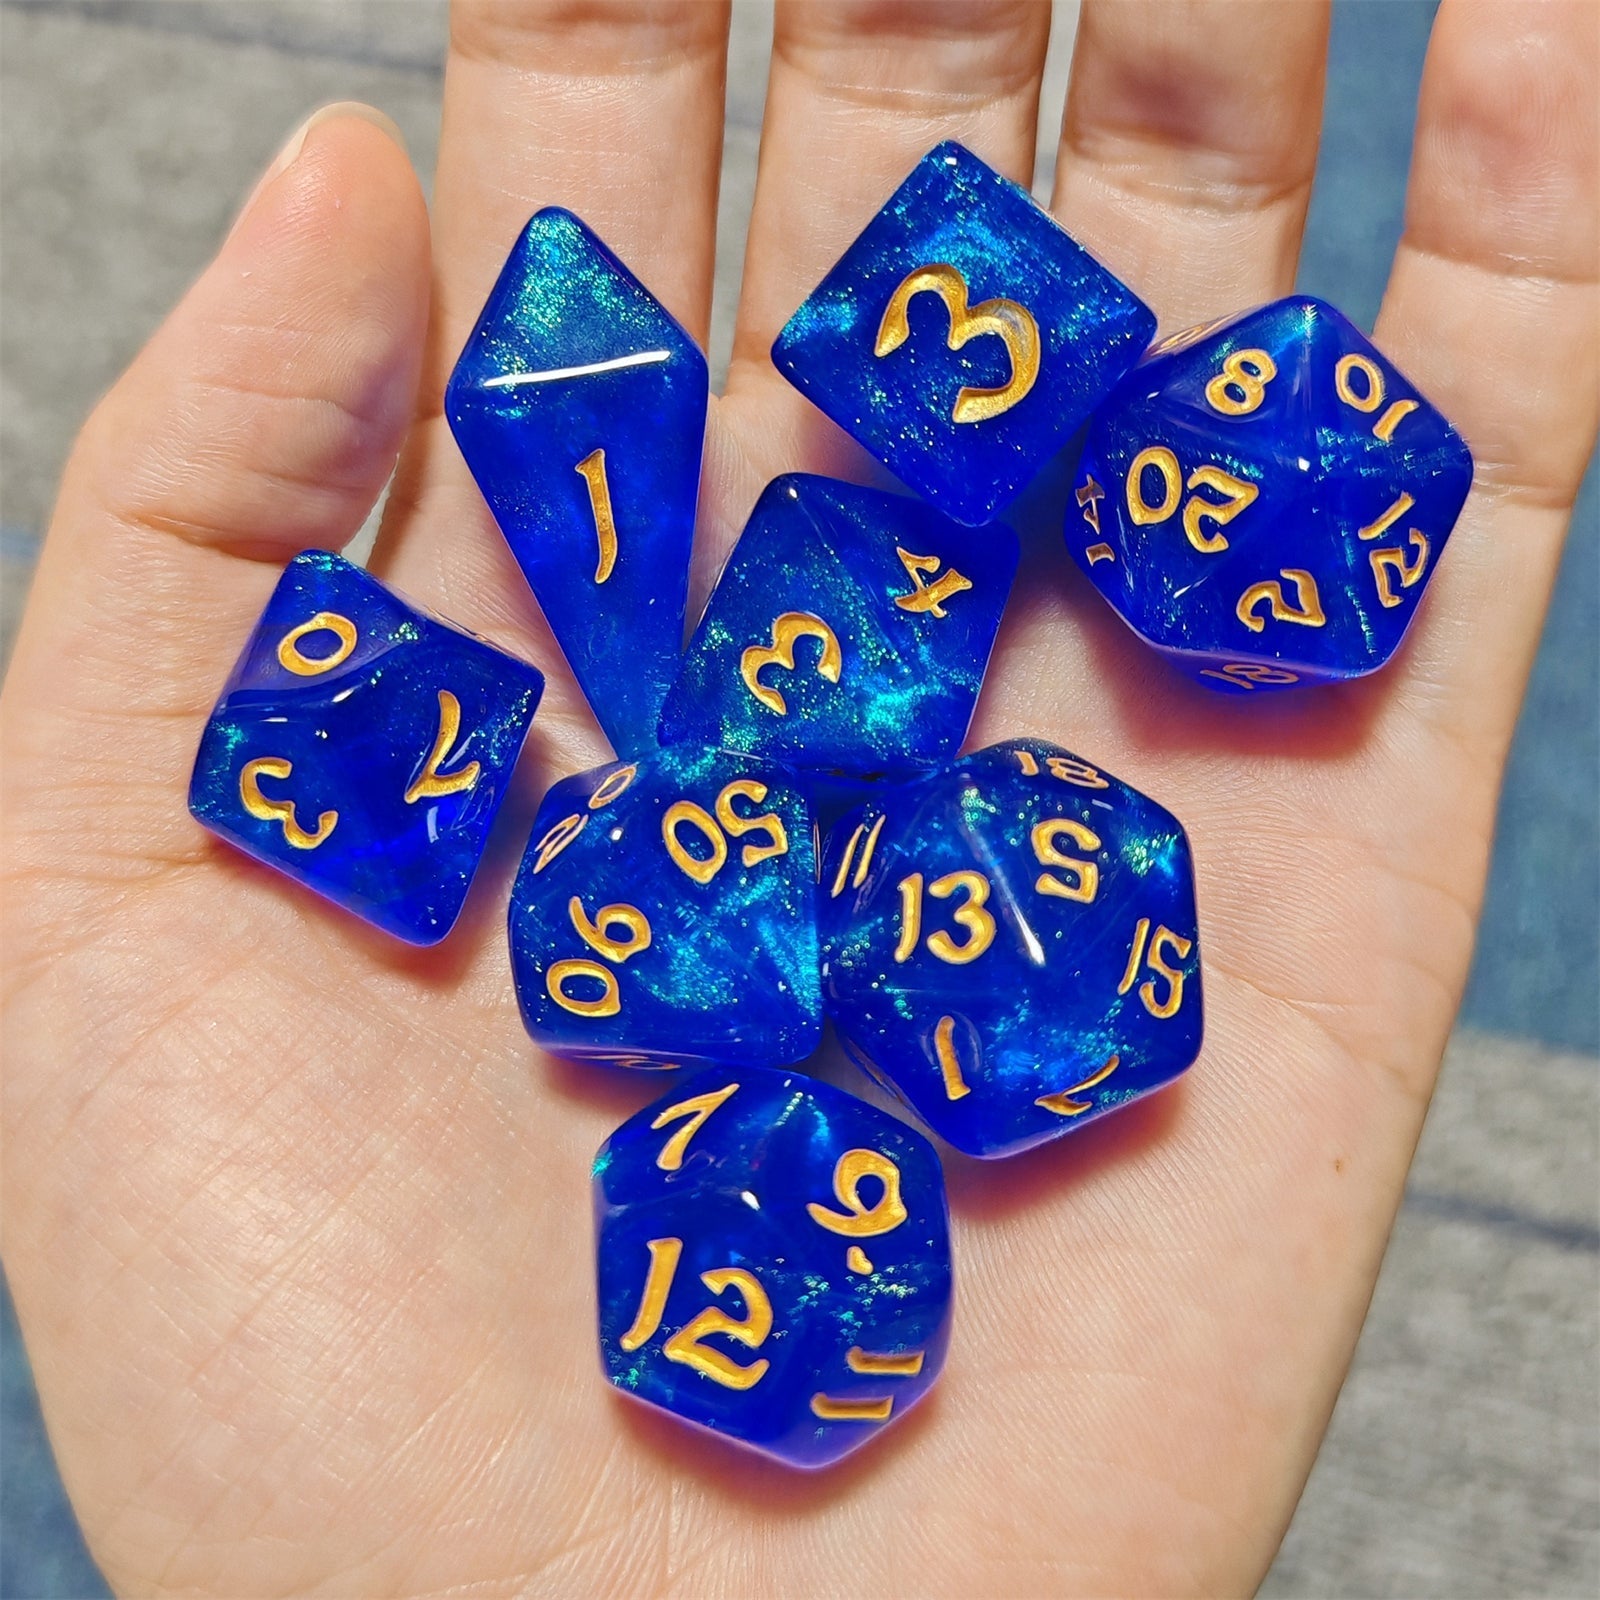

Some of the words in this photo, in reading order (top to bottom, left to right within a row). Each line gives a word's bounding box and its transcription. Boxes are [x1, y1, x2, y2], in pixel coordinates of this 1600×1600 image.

[874, 264, 1041, 423] 3
[1205, 349, 1277, 416] 8
[1335, 354, 1418, 442] 10
[575, 448, 619, 584] 1
[1126, 446, 1259, 553] 20
[895, 547, 973, 618] 4
[1359, 492, 1429, 608] 12
[1236, 569, 1327, 633] 2
[741, 612, 842, 714] 3
[404, 690, 480, 804] 7
[240, 757, 338, 849] 3
[662, 780, 788, 883] 50
[1031, 818, 1101, 903] 5
[546, 896, 651, 1017] 90
[894, 871, 996, 964] 13
[1118, 918, 1192, 1019] 15
[934, 1016, 971, 1100] 1
[1034, 1055, 1120, 1116] 7
[652, 1083, 740, 1171] 7
[620, 1237, 774, 1391] 12
